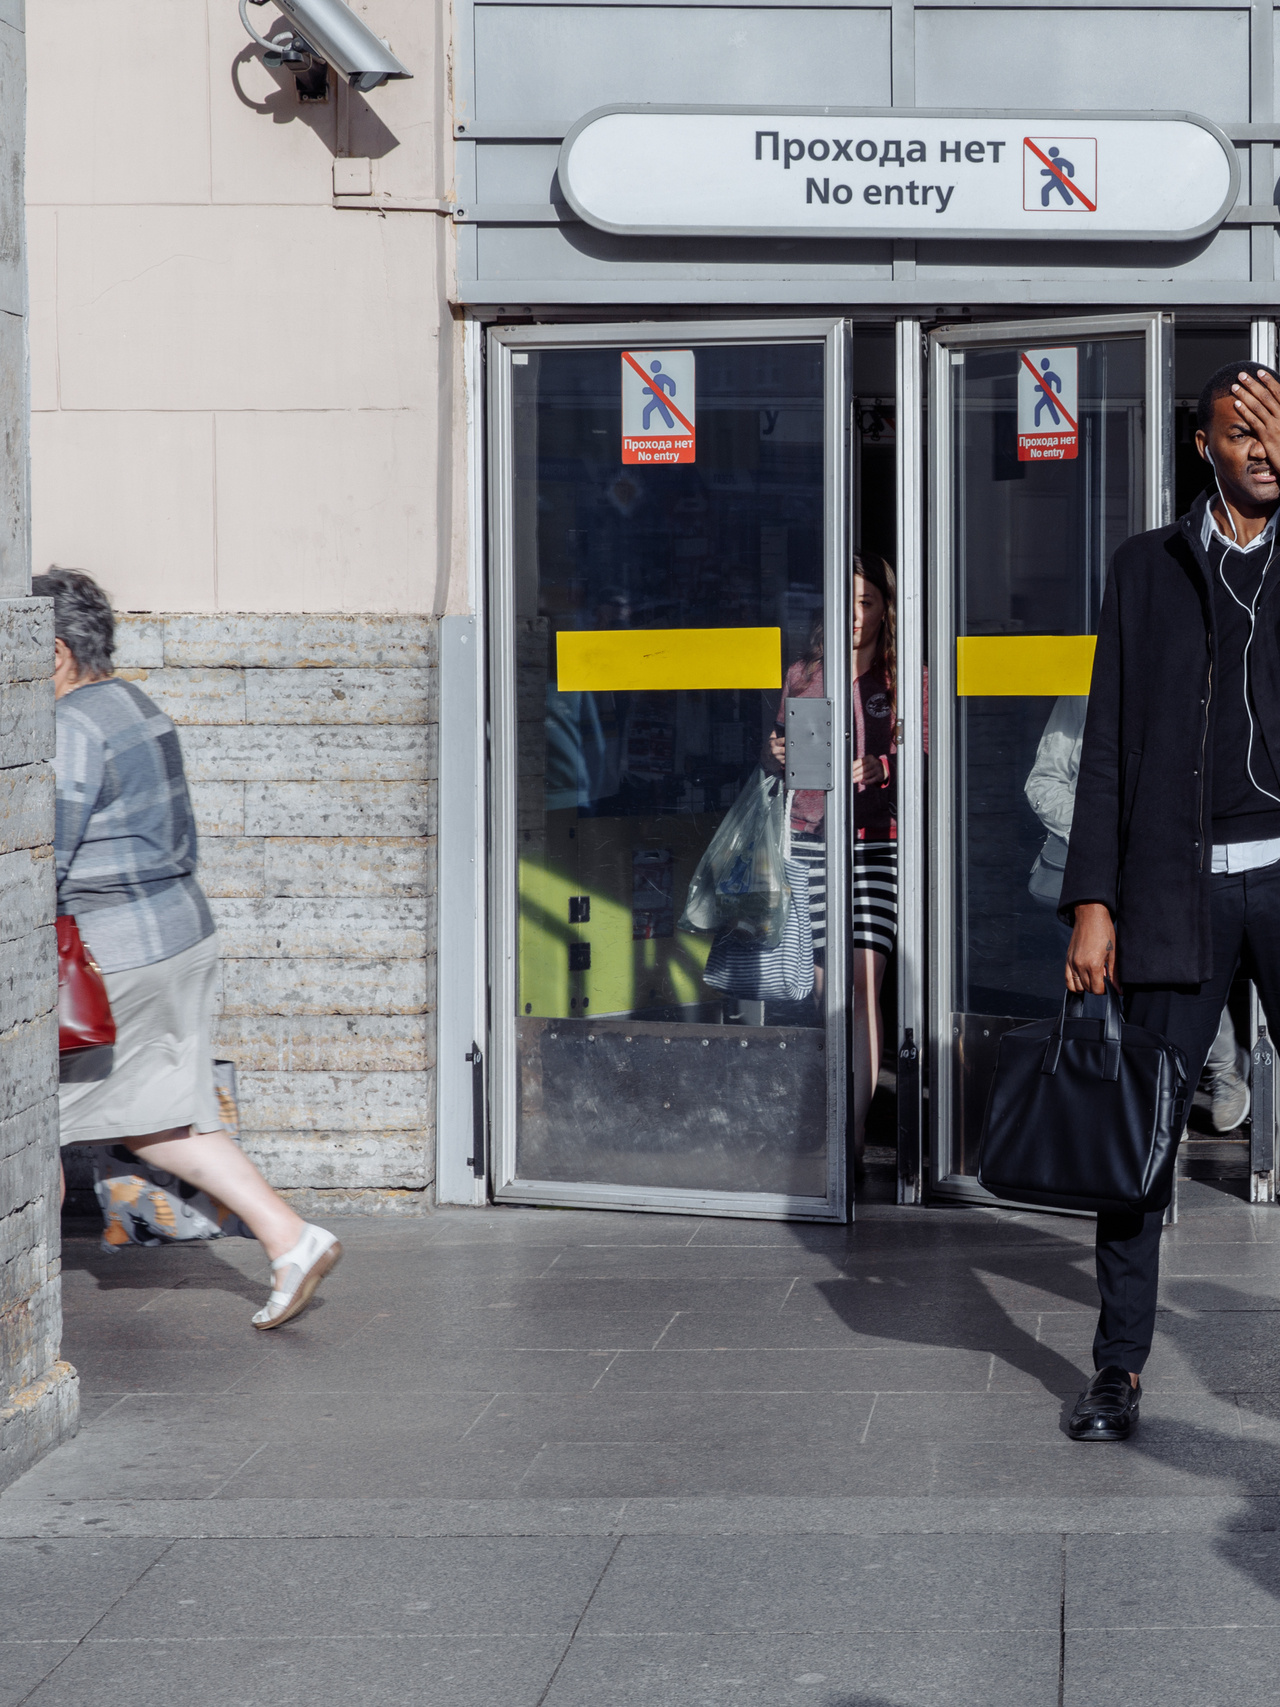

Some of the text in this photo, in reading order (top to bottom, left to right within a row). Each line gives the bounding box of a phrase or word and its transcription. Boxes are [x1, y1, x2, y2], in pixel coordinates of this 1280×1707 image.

[755, 130, 1006, 170] Прохода нет
[806, 177, 955, 214] No entry
[624, 438, 694, 452] Прохода нет
[1019, 436, 1076, 449] Прохода нет
[637, 451, 680, 462] No entry
[1030, 448, 1065, 459] No entry
